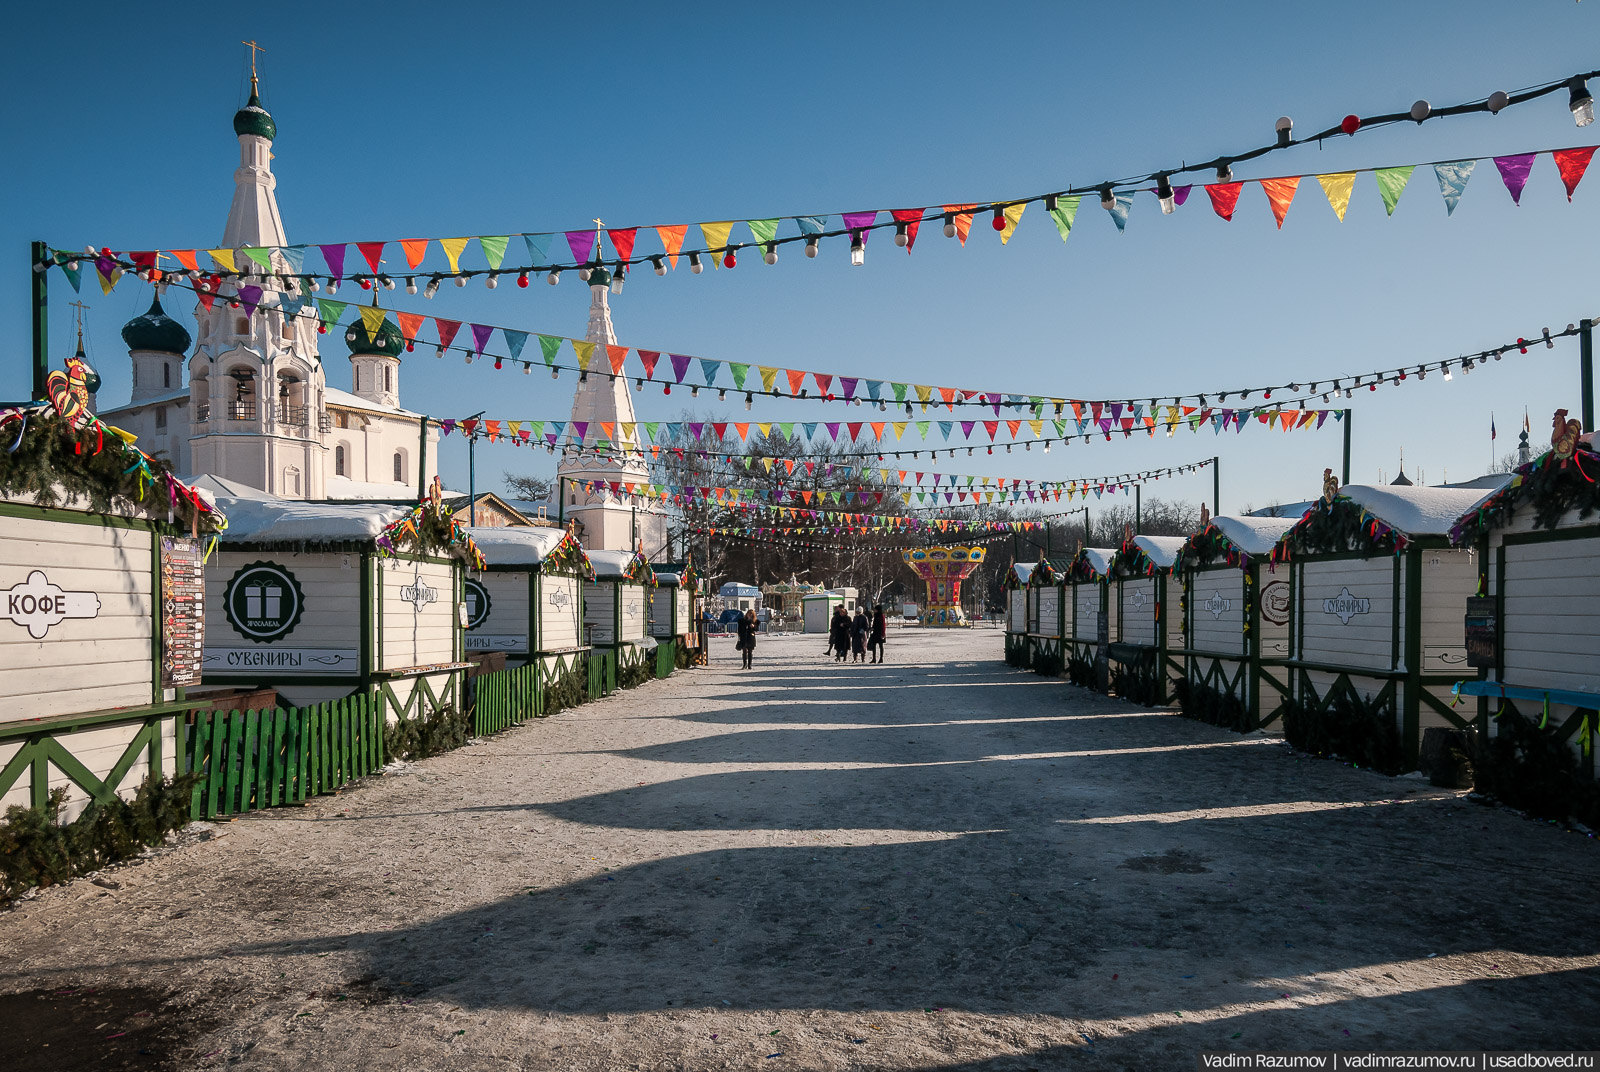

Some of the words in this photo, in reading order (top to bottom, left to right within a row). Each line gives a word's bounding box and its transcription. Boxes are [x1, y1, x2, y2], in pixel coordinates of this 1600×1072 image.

[174, 543, 190, 552] МЕНЮ
[8, 595, 66, 615] КОФЕ
[1327, 599, 1364, 613] СУВЕНИРЫ
[227, 651, 302, 666] СУВЕНИРЫ
